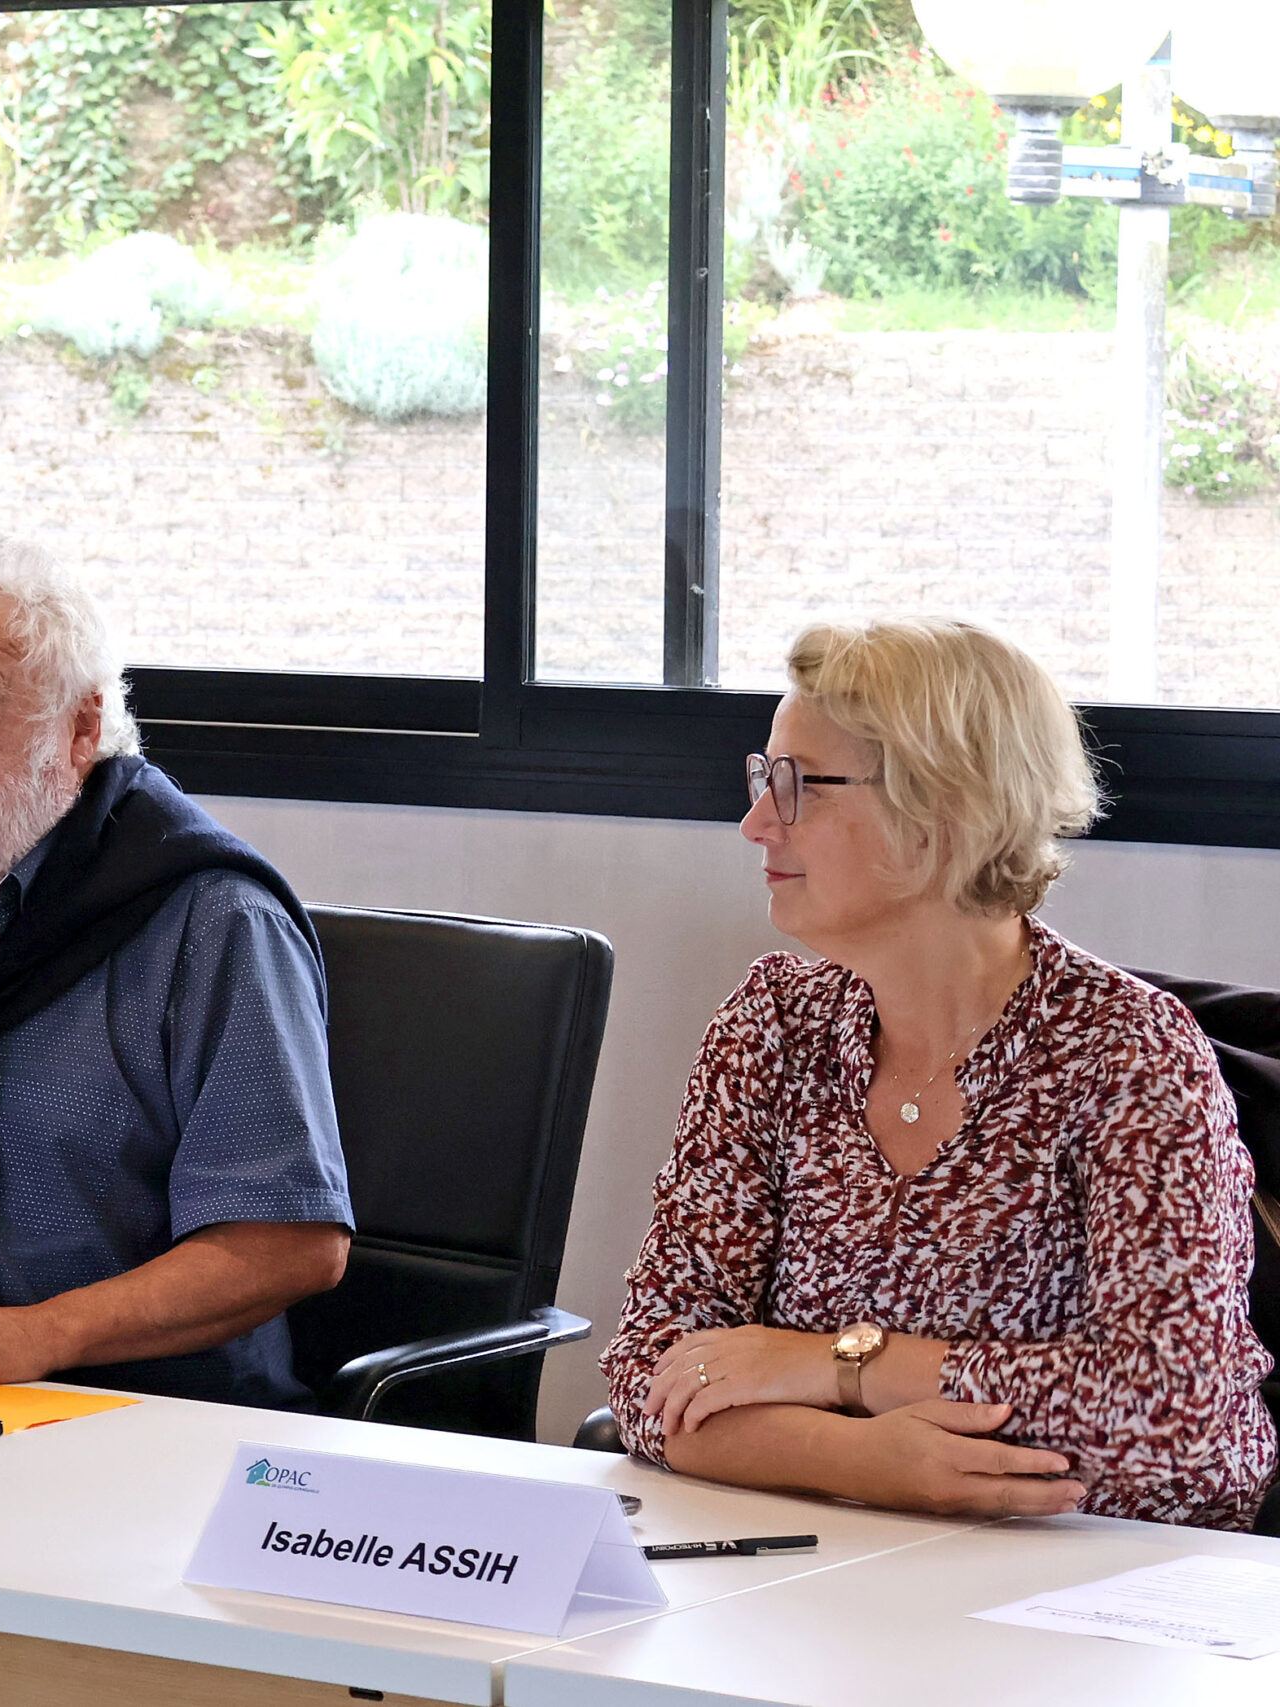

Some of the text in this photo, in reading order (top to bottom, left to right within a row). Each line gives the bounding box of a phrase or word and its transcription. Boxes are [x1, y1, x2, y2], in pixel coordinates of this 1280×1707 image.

[265, 1466, 312, 1487] OPAC
[261, 1521, 519, 1585] Isabelle ASSIH
